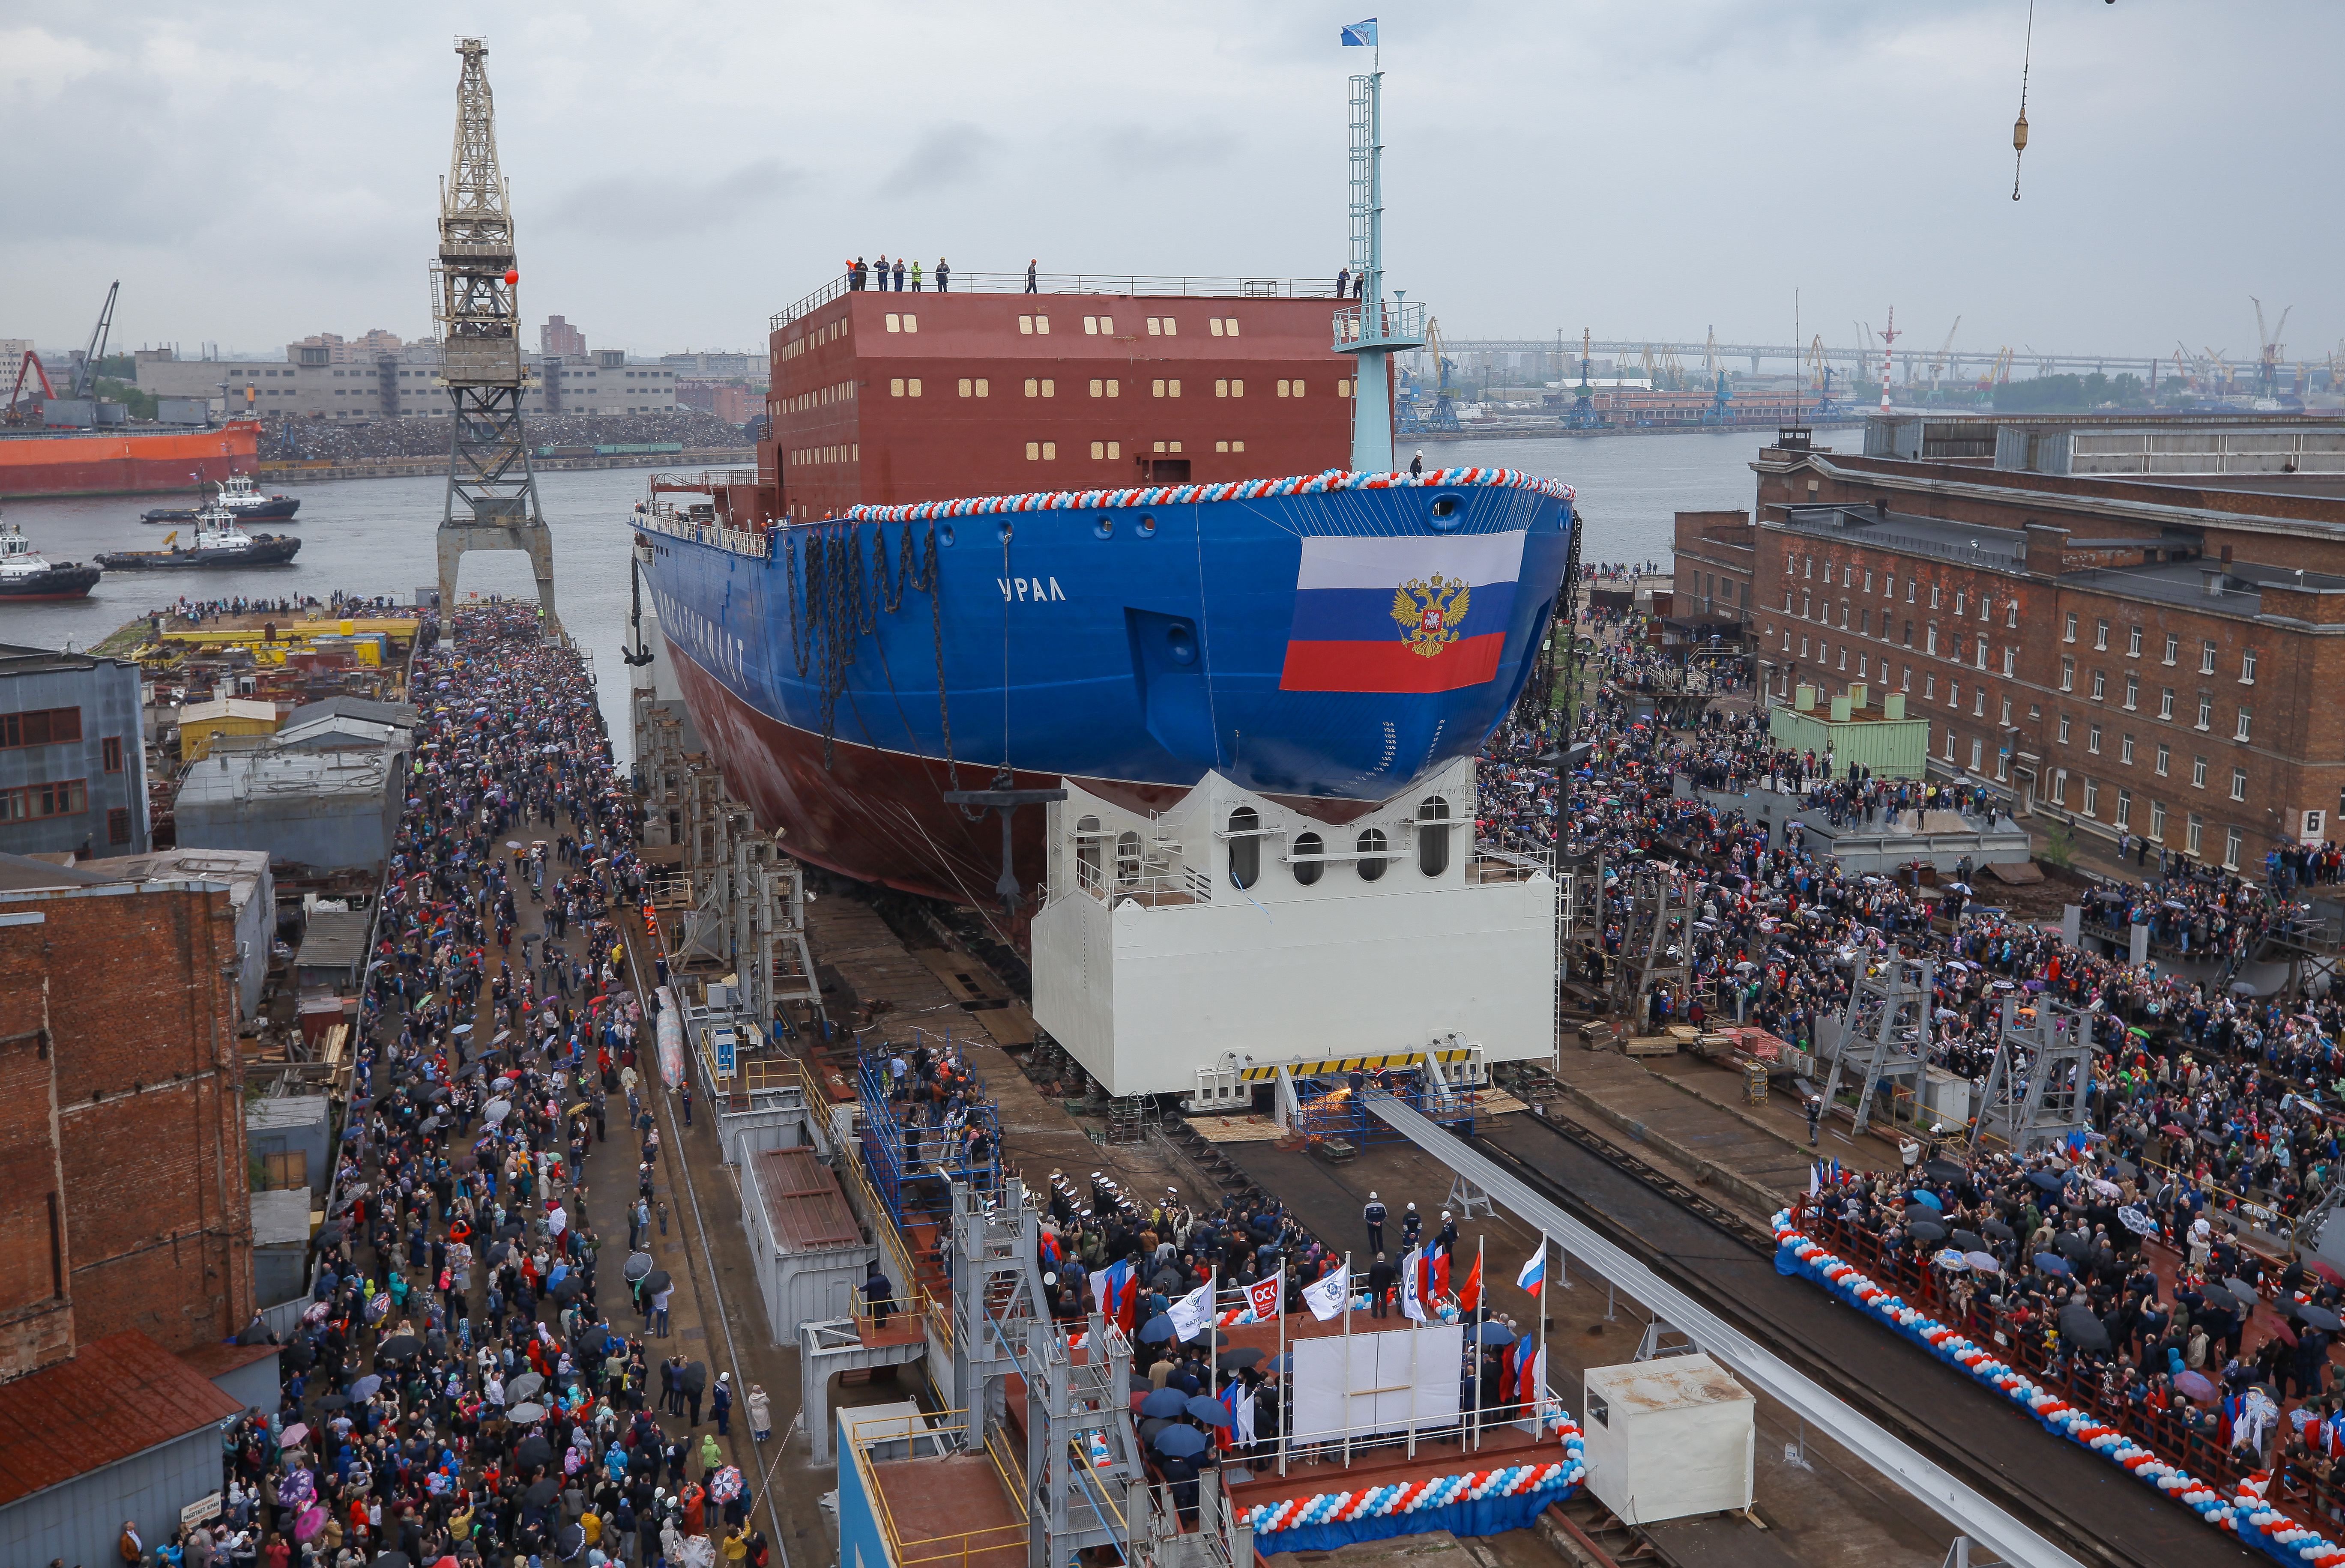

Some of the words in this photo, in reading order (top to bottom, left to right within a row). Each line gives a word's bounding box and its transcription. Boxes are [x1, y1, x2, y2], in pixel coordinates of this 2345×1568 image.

[997, 577, 1066, 601] УРАЛ
[2307, 811, 2320, 831] 6
[184, 1507, 206, 1522] РАБОТАЕТ
[207, 1501, 220, 1510] КРАН
